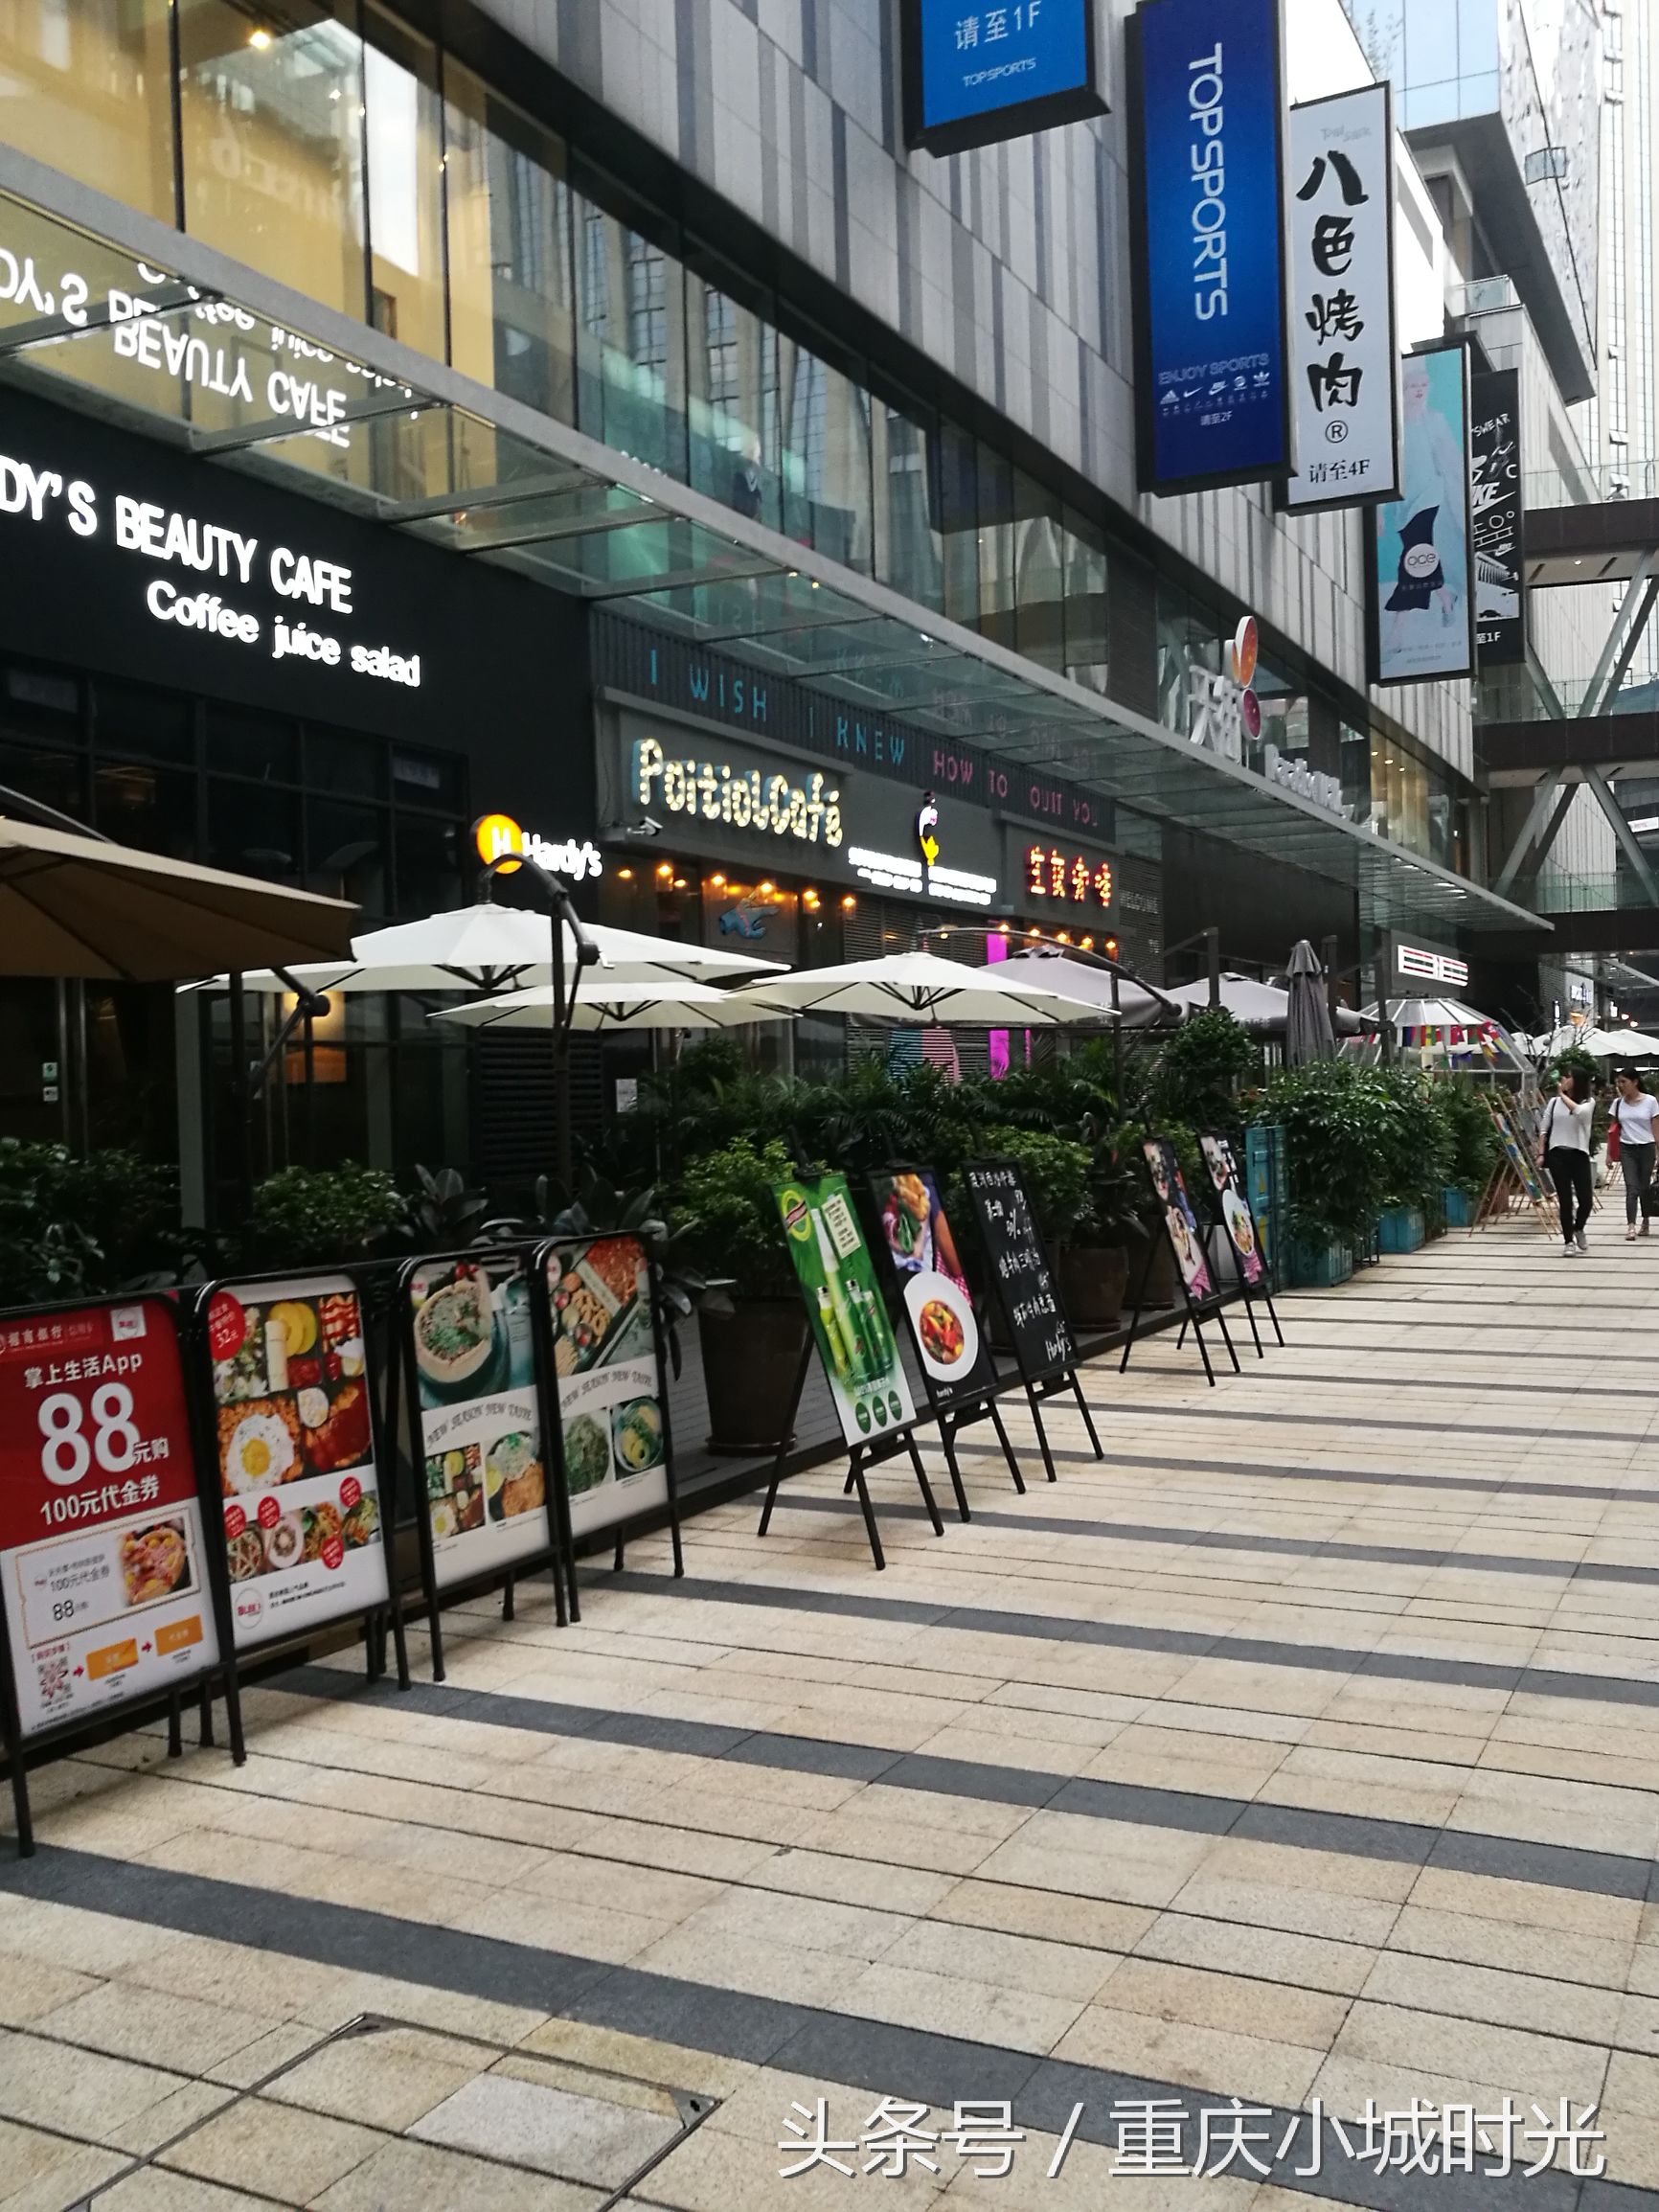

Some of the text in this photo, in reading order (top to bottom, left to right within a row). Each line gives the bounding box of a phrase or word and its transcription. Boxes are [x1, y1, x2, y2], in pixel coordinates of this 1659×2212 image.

[955, 1, 1042, 50] 请至1F
[962, 57, 1037, 87] TOPSPORTS
[1189, 42, 1229, 322] TOPSPORTS
[1296, 149, 1370, 413] 八色烤肉
[1158, 353, 1269, 385] ENJOY SPORTS
[1308, 459, 1371, 484] 请至4F
[115, 494, 259, 583] BEAUTY
[270, 547, 353, 614] CAFE
[147, 580, 421, 688] Coffee juice salad
[690, 663, 766, 723] WISH
[836, 716, 905, 766] KNEW
[933, 750, 974, 785] HOW
[989, 769, 1009, 799] TO
[24, 1352, 144, 1389] 掌上生活App
[37, 1381, 141, 1487] 88
[40, 1473, 160, 1526] 100元代金券
